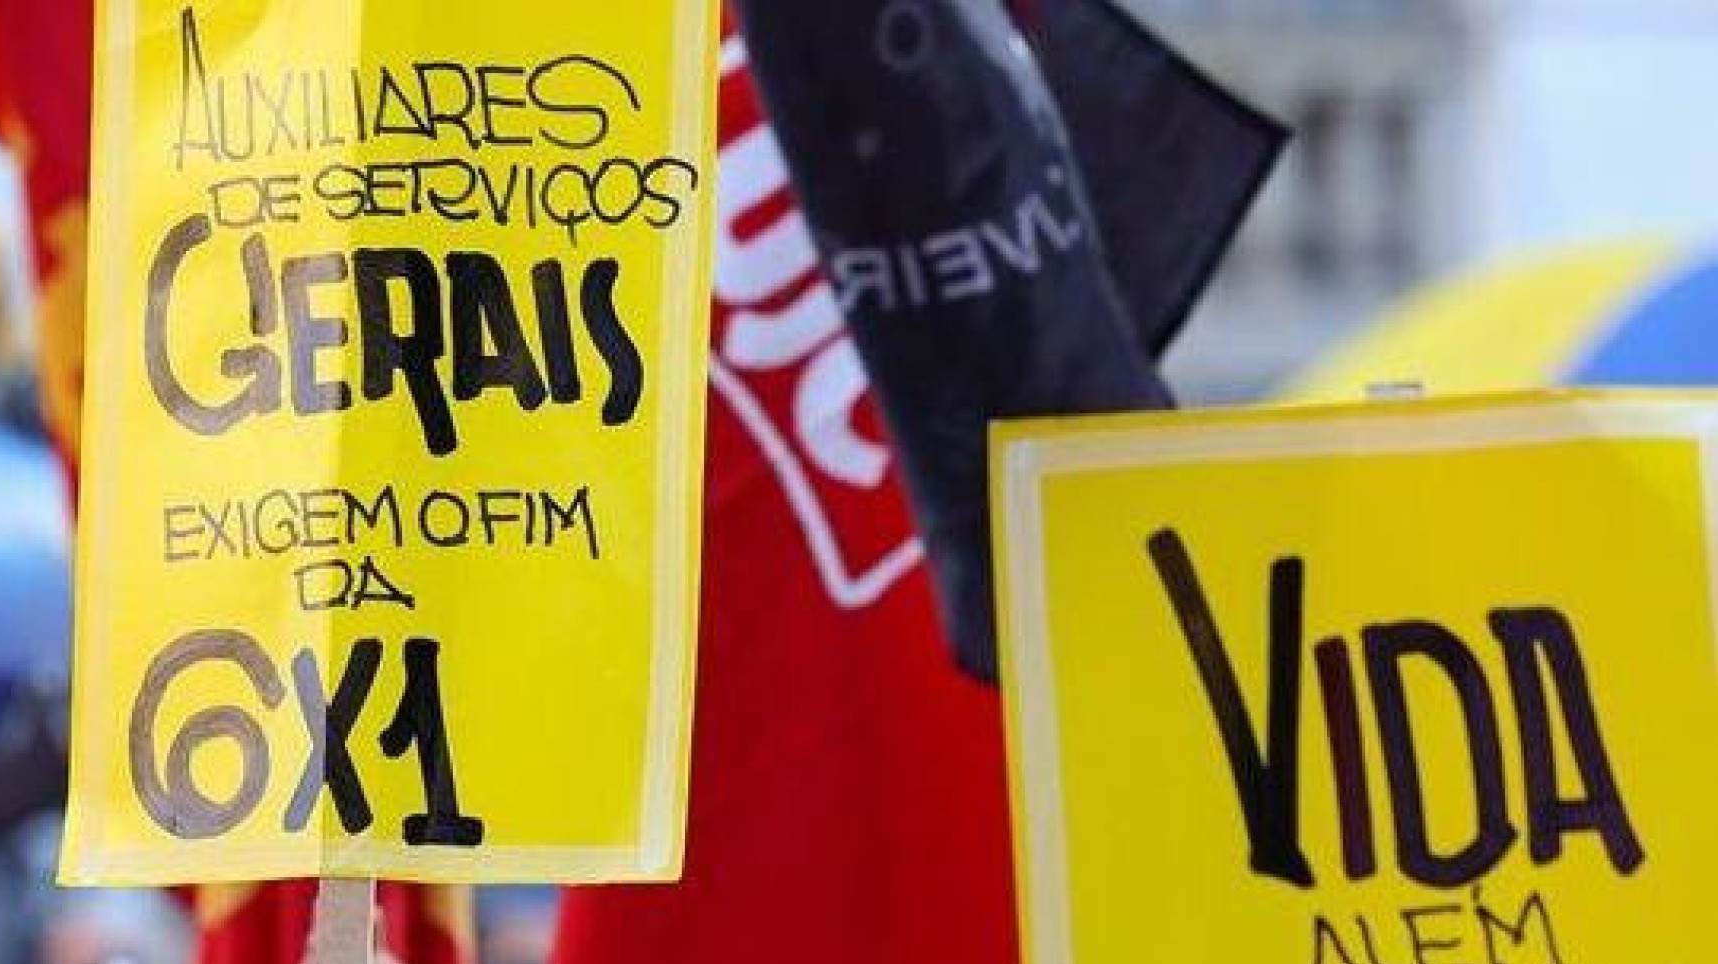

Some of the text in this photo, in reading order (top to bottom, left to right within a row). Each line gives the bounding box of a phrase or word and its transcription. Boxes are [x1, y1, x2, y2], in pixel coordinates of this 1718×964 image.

[207, 157, 699, 248] DE SERVIÇOS
[143, 212, 645, 458] GERAIS
[162, 483, 403, 562] EXIGEM
[292, 555, 416, 612] DA
[128, 628, 486, 850] 6X1
[1144, 526, 1647, 892] VIDA
